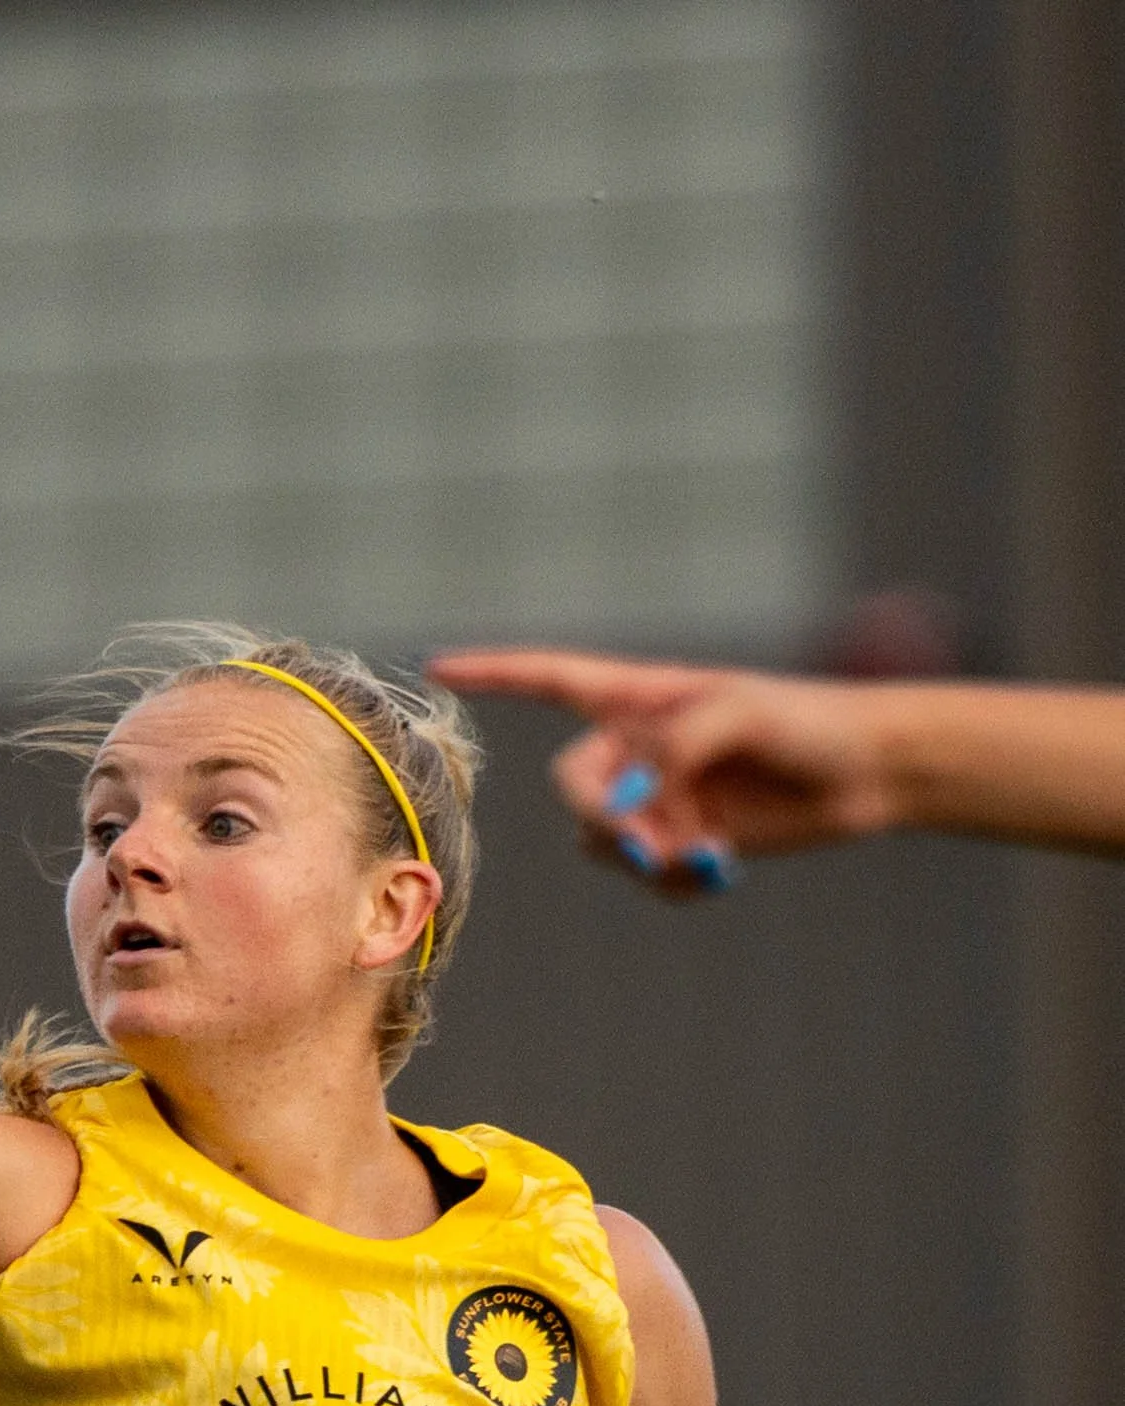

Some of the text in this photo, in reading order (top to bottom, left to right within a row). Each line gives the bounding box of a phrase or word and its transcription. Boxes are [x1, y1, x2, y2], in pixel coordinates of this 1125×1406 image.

[131, 1273, 233, 1287] ARETYN
[455, 1292, 572, 1364] SUNFLOWER STATE
